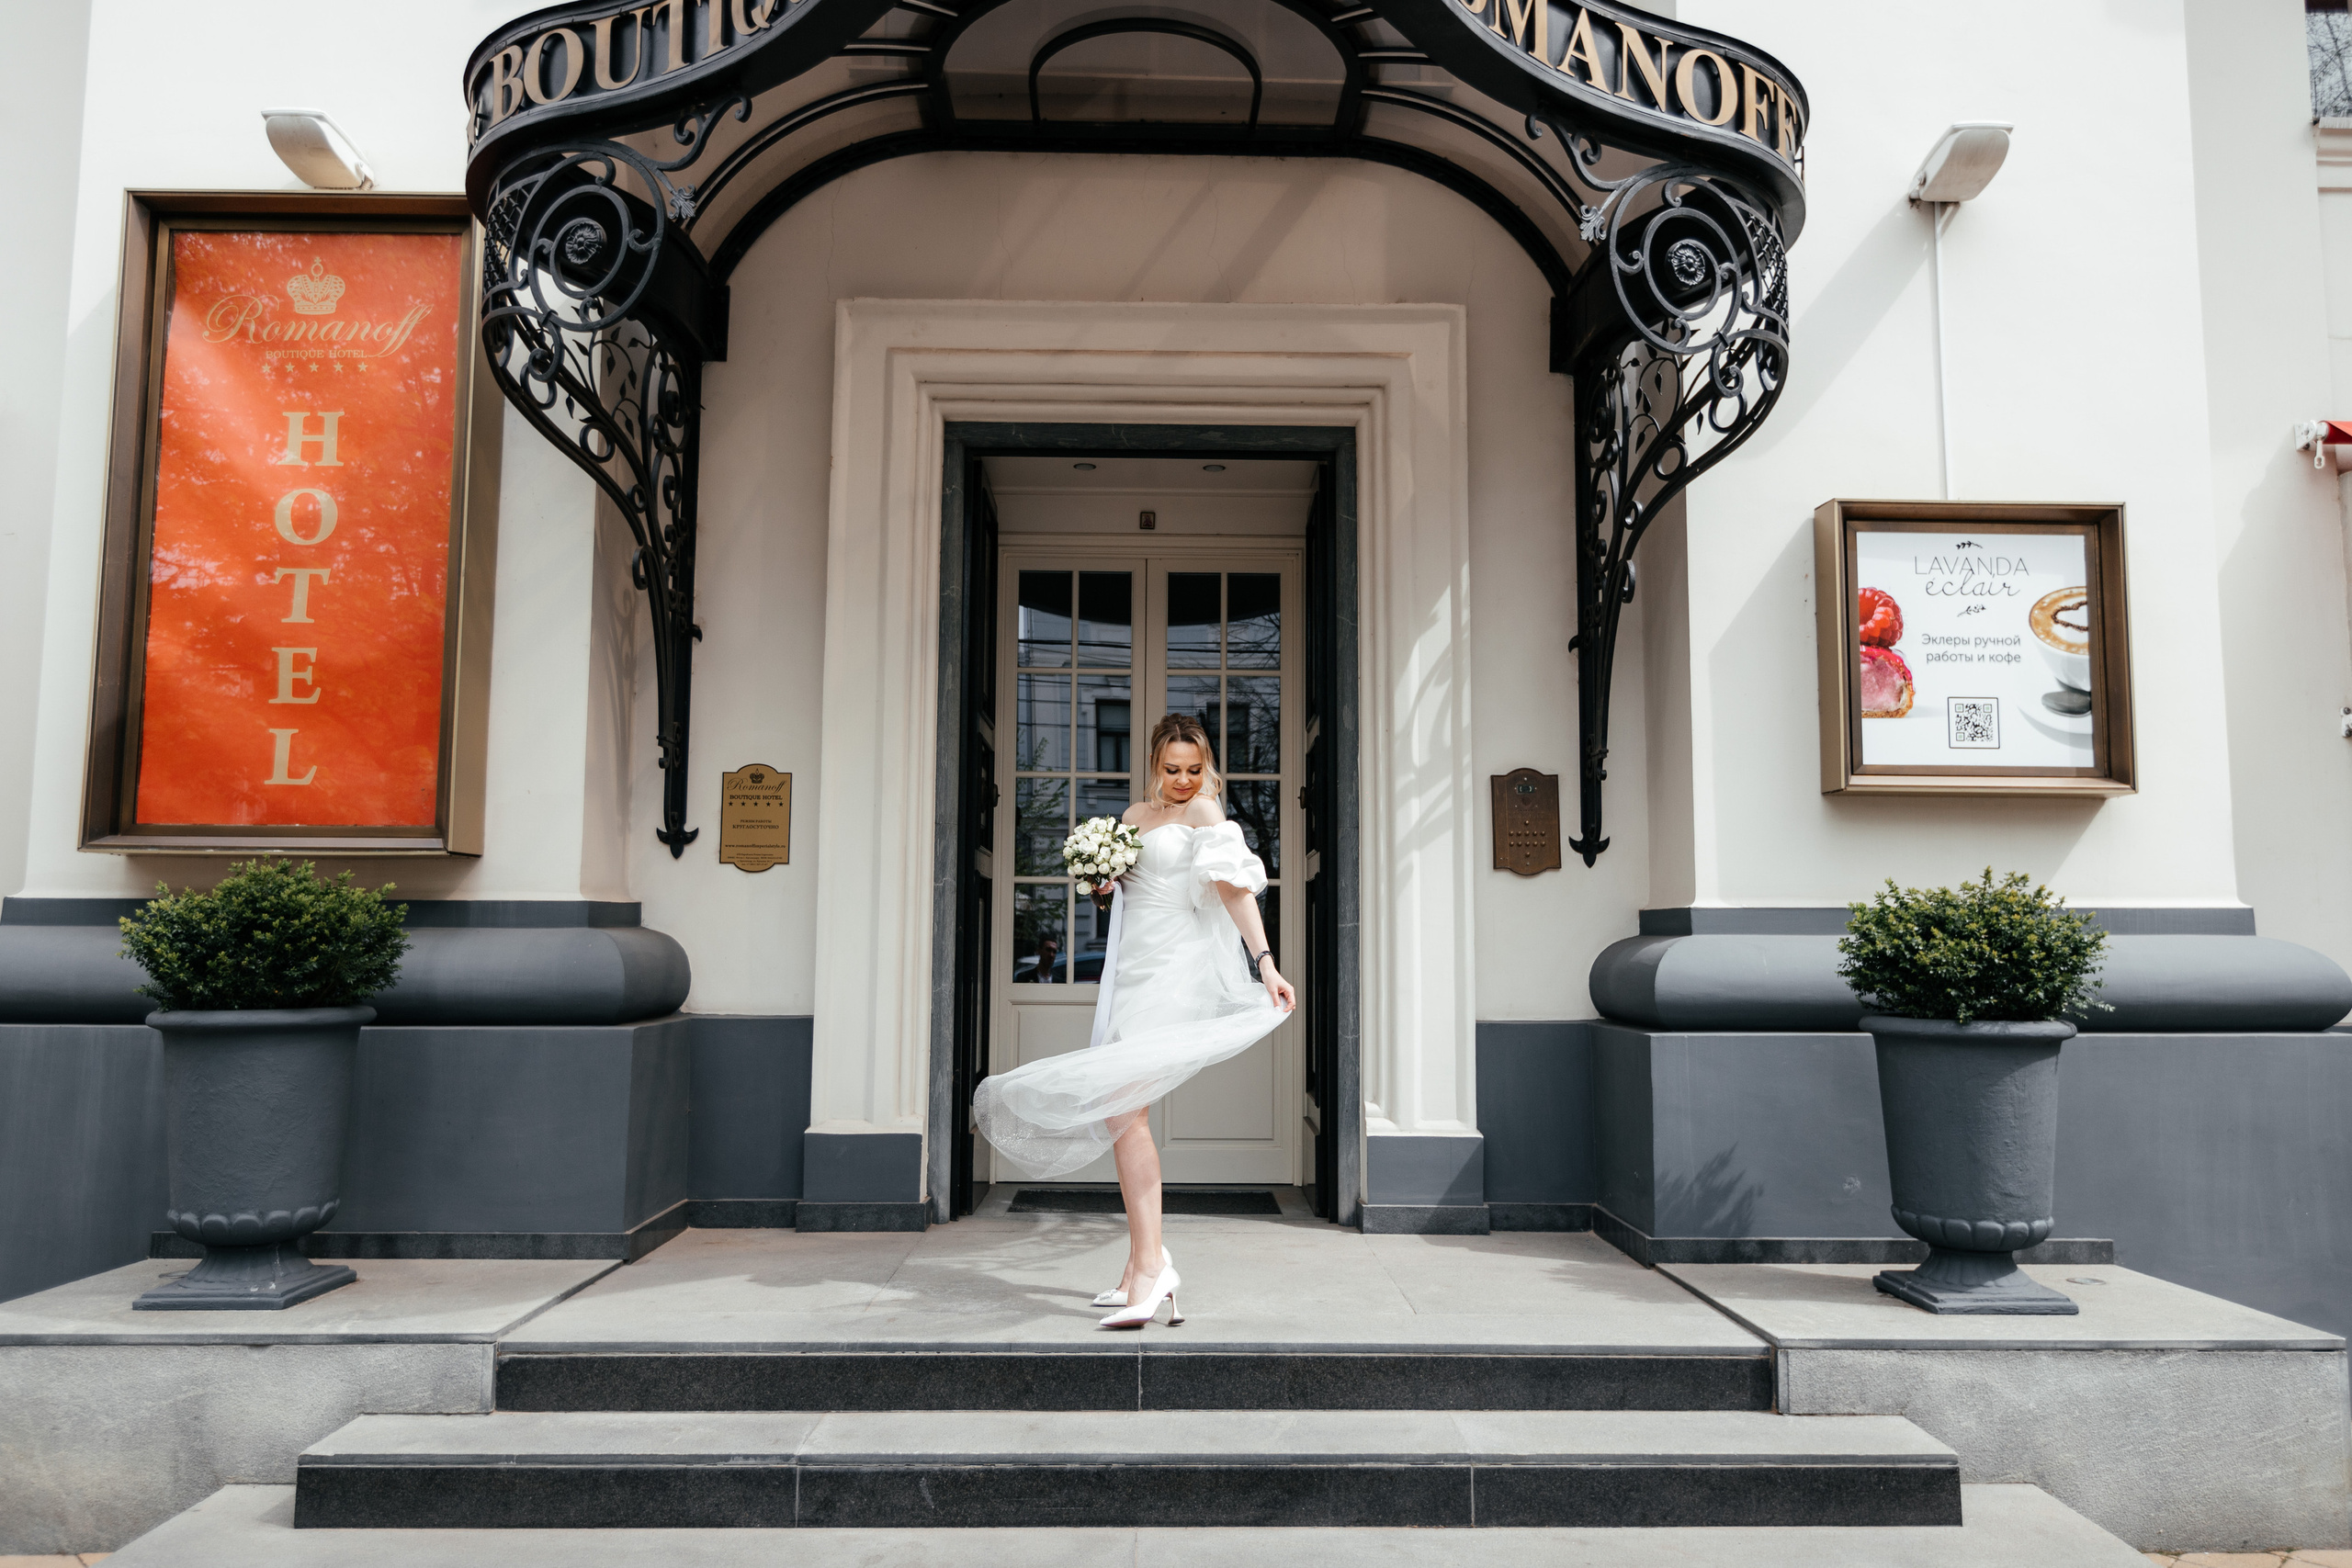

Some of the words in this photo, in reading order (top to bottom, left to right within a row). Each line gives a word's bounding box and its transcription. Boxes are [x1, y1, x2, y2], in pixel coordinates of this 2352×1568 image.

[490, 0, 802, 129] BOUTIQ
[1457, 0, 1797, 162] MANOFF
[201, 294, 435, 358] Romanoff
[266, 349, 324, 360] BOUTIQUE
[329, 349, 368, 359] HOTEL
[1914, 555, 2030, 576] LAVANDA
[264, 411, 346, 785] HOTEL
[1921, 634, 1971, 648] Эклеры
[1974, 635, 2020, 648] ручной
[1926, 651, 1973, 664] работы
[1977, 653, 1985, 662] и
[1988, 652, 2021, 665] кофе
[727, 777, 787, 795] Romanoff
